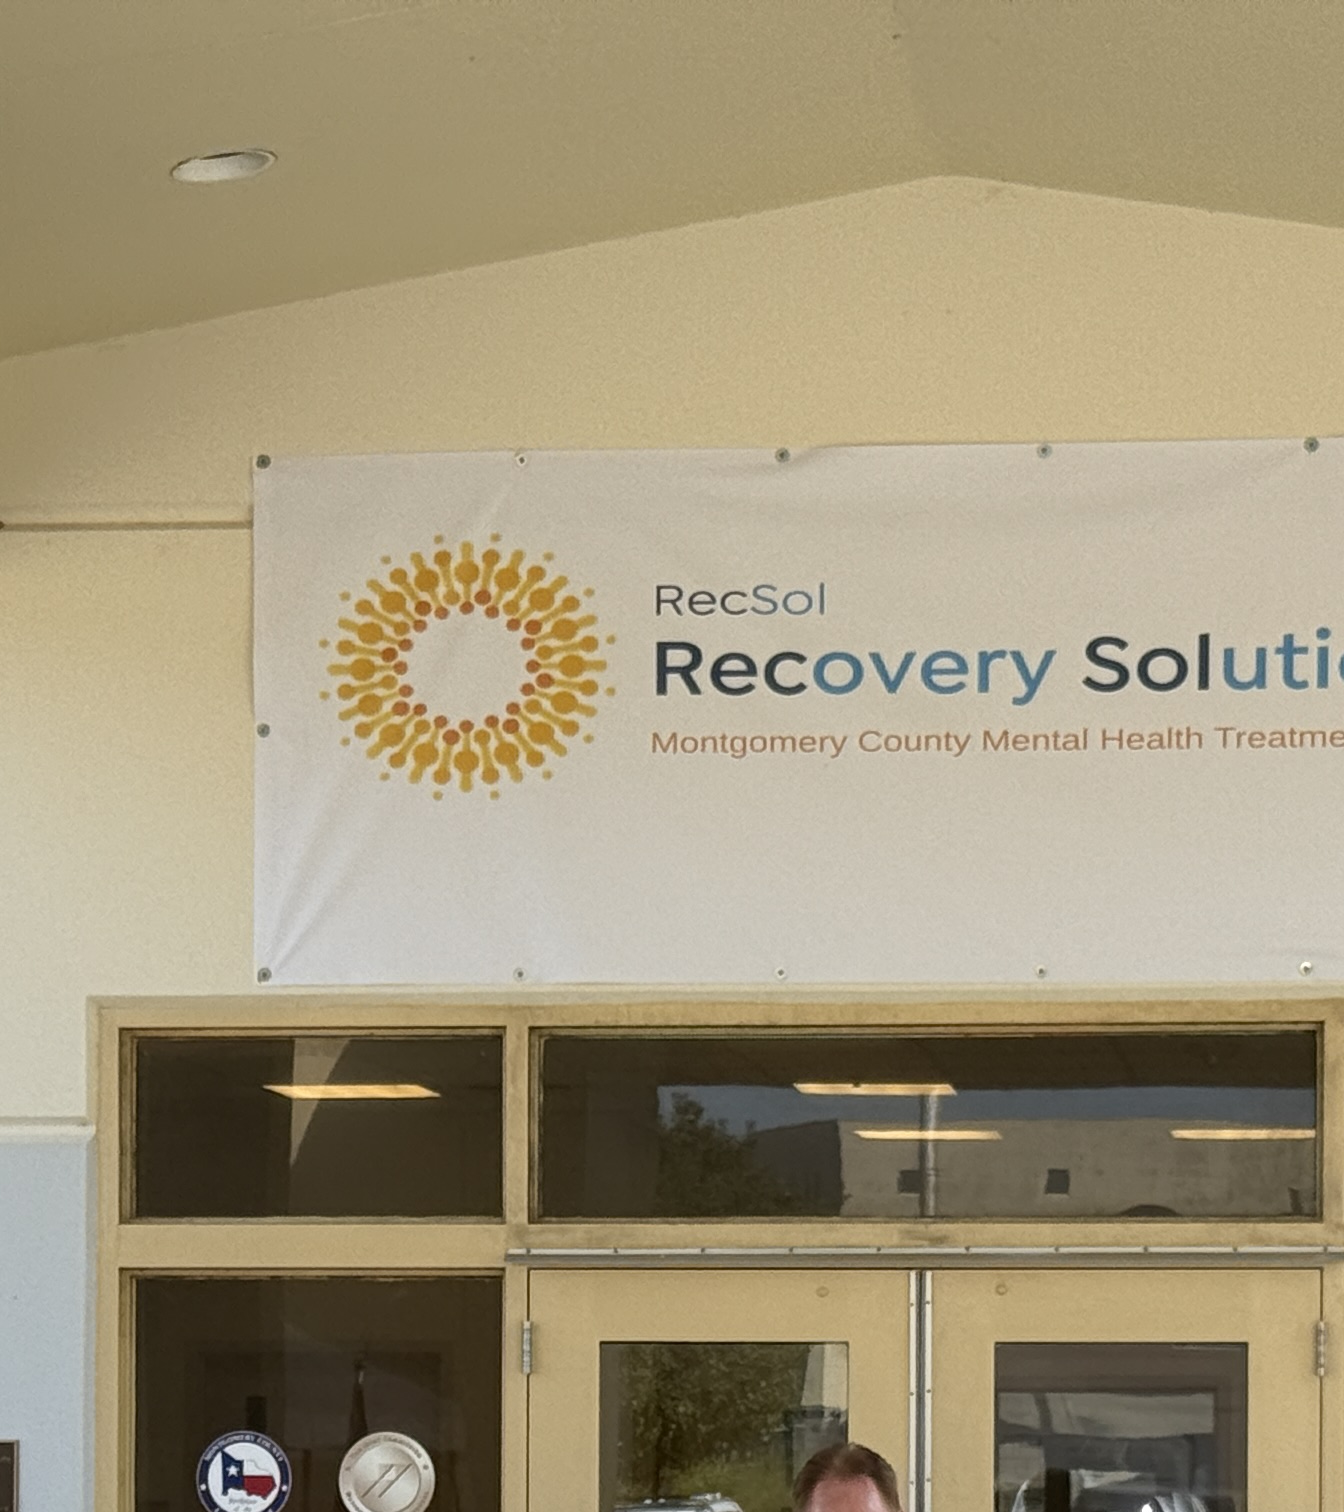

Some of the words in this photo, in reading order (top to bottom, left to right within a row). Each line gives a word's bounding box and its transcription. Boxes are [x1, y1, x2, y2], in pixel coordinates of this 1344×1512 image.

[653, 581, 827, 617] RecSol
[655, 640, 1057, 706] Recovery
[652, 728, 847, 759] Montgomery
[858, 728, 973, 758] County
[983, 726, 1089, 752] Mental
[1102, 725, 1204, 751] Health
